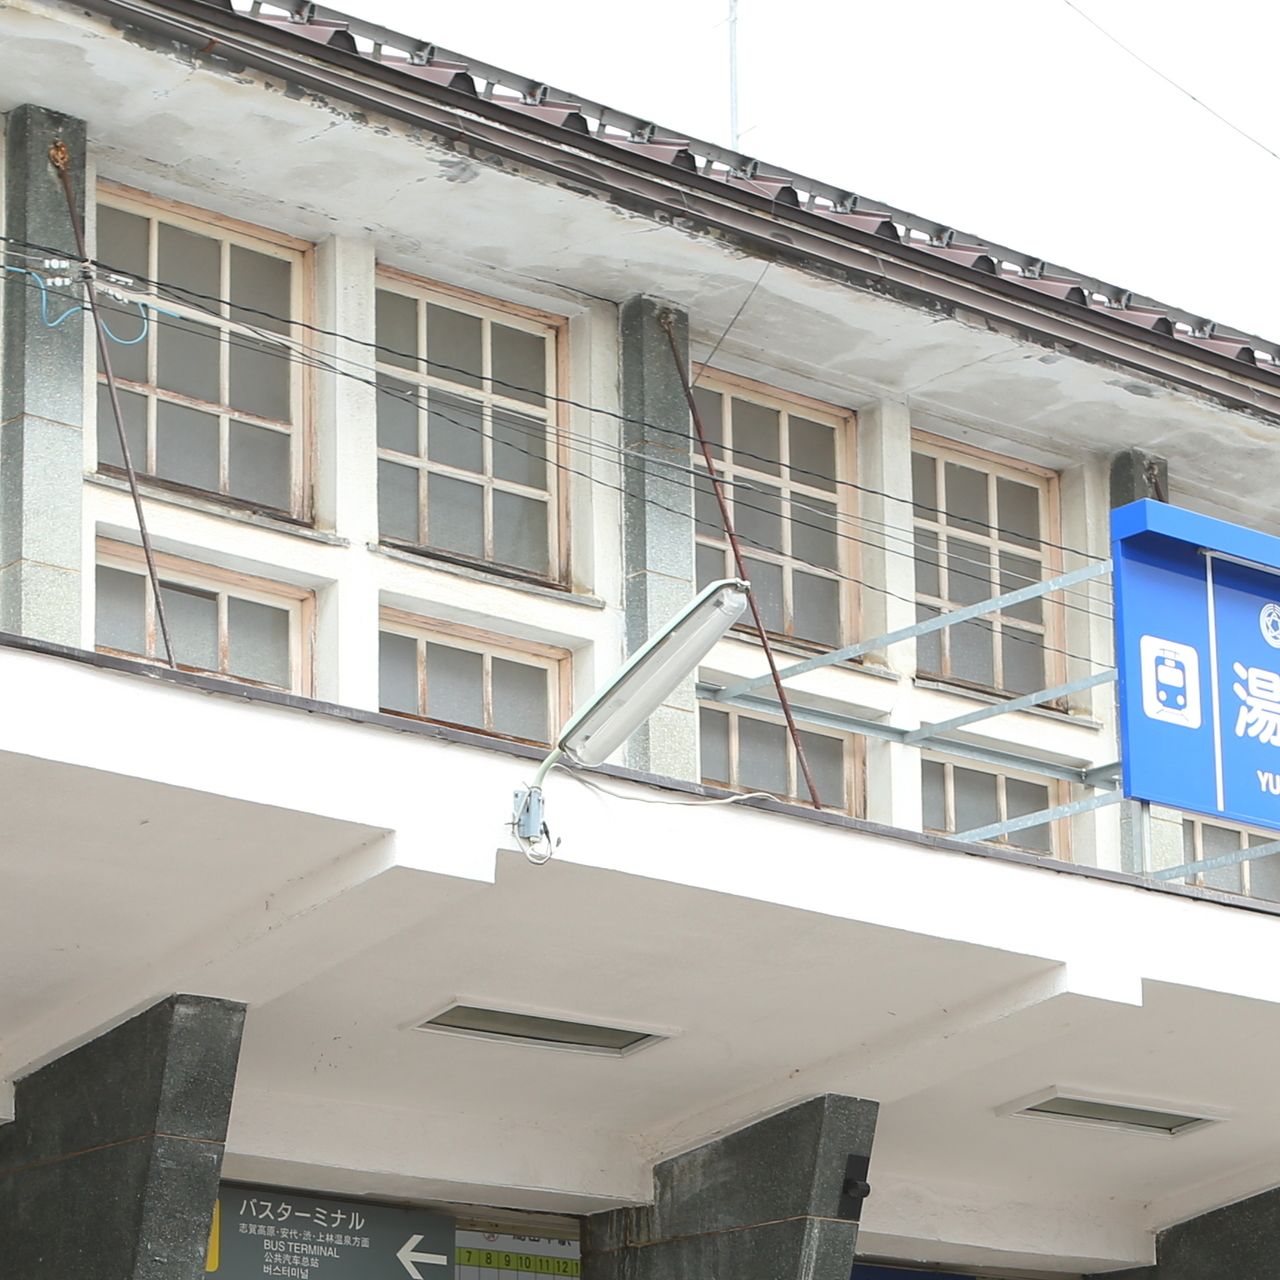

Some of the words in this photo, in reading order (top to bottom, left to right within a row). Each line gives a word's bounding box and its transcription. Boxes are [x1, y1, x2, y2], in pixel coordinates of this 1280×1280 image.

[239, 1198, 365, 1231] バスターミナル
[263, 1239, 287, 1252] BUS
[287, 1241, 340, 1259] TERMINAL
[264, 1251, 320, 1268] 公共汽车总站
[465, 1251, 472, 1263] 7
[485, 1252, 493, 1265] 8
[504, 1254, 511, 1267] 9
[519, 1256, 531, 1269] 10
[539, 1259, 550, 1271] 11
[556, 1260, 569, 1273] 12
[263, 1264, 309, 1280] 버스터미널
